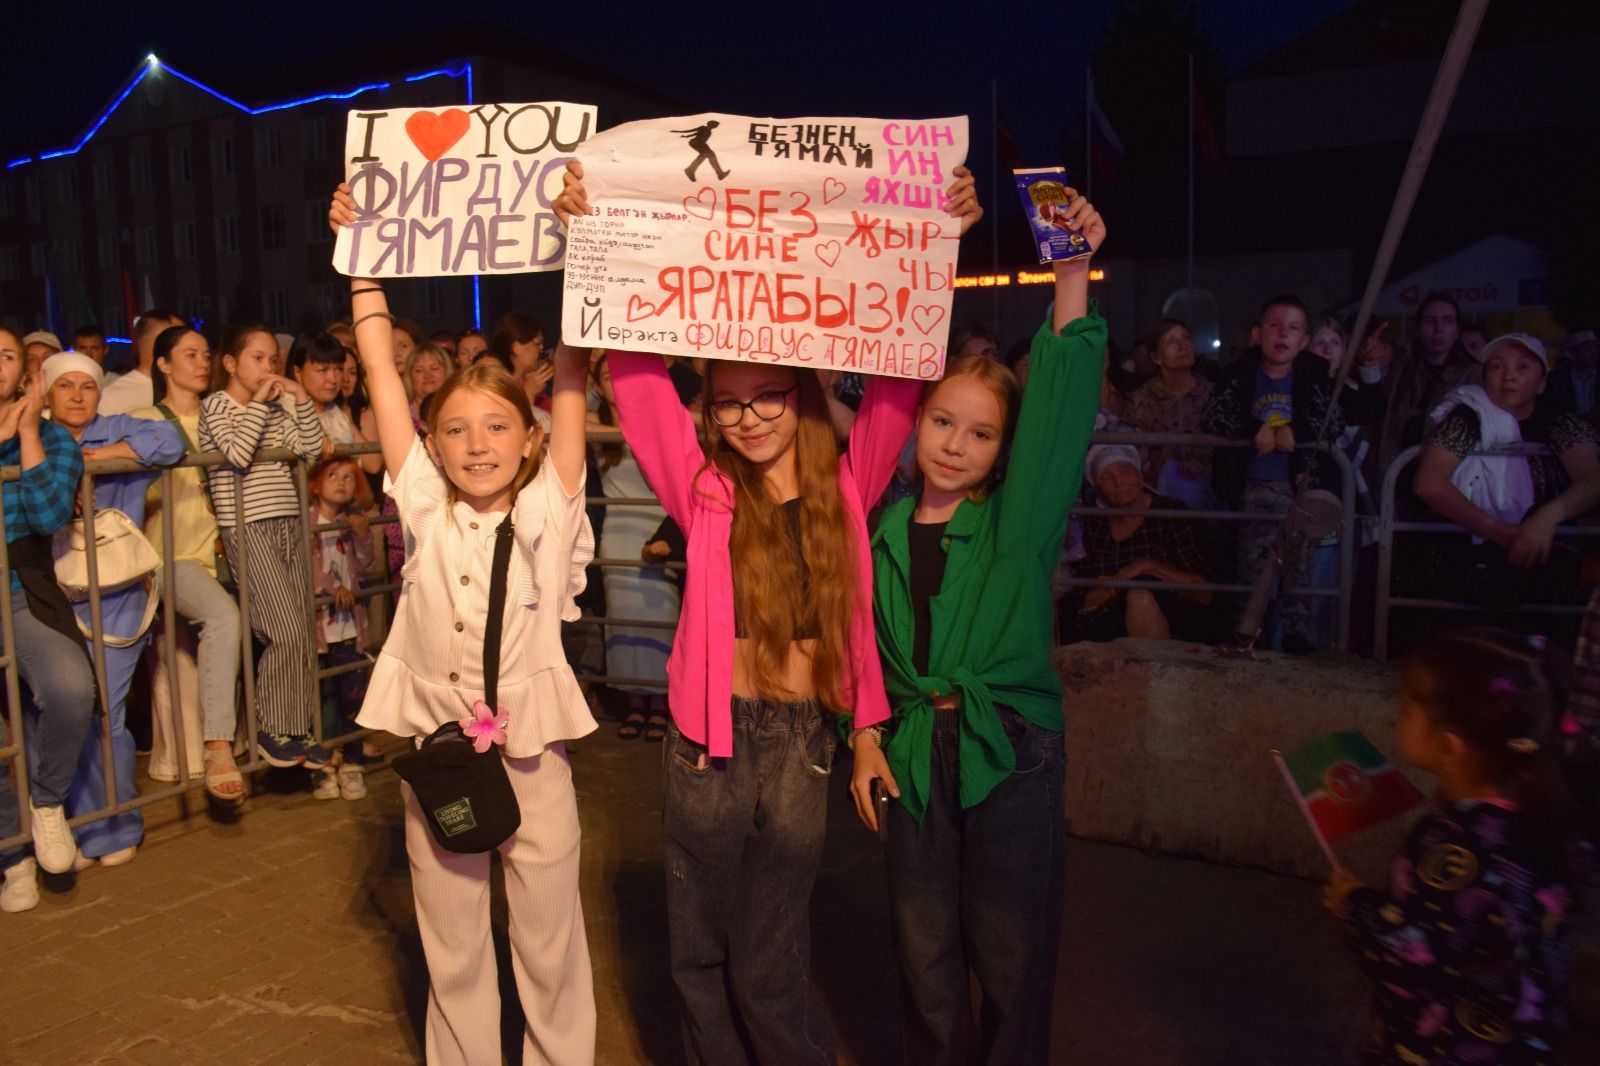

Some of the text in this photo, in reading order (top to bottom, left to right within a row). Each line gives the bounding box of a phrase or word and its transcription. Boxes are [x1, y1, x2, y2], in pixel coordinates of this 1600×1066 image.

[351, 104, 590, 162] I YOU
[749, 140, 873, 169] ТЯМАЙ
[882, 123, 954, 146] СИН
[349, 157, 579, 221] ФИРДУС
[725, 188, 818, 238] БЕЗ
[348, 213, 567, 275] ТЯМАЕВ
[705, 230, 799, 262] СИНЕ
[899, 258, 954, 292] ЧЫ
[655, 266, 910, 337] ЯРАТАБЫЗ!
